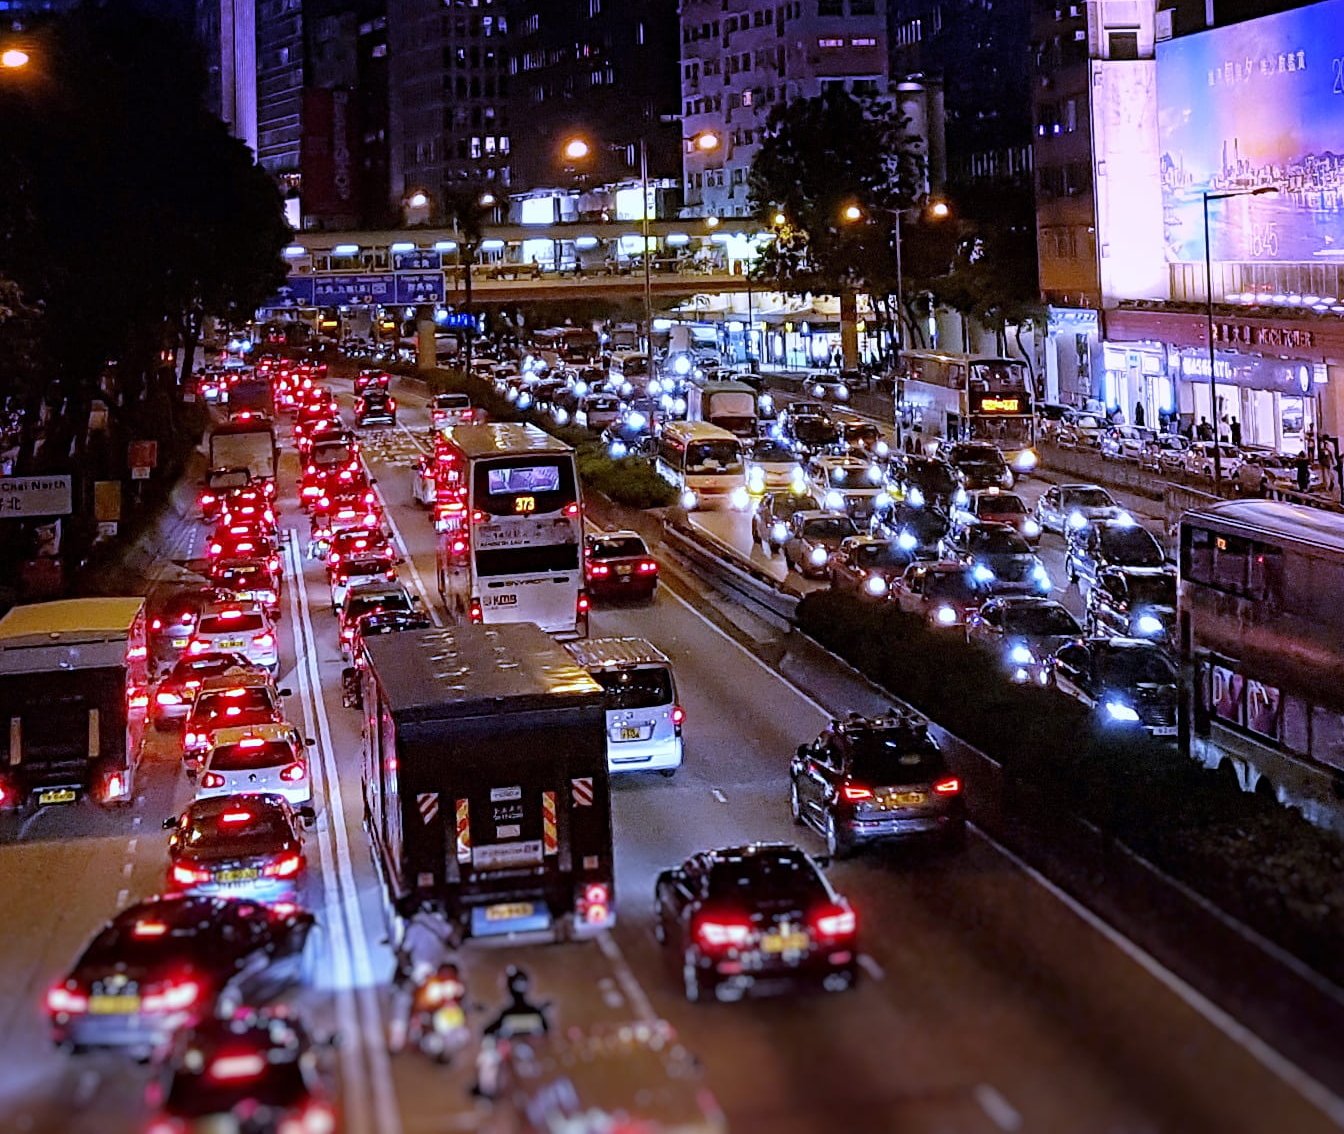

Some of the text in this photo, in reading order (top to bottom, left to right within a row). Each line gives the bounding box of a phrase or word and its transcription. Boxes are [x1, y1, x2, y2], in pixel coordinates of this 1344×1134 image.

[1, 482, 28, 493] Chai
[31, 480, 66, 491] North
[515, 496, 535, 512] 373
[493, 594, 518, 606] KMB
